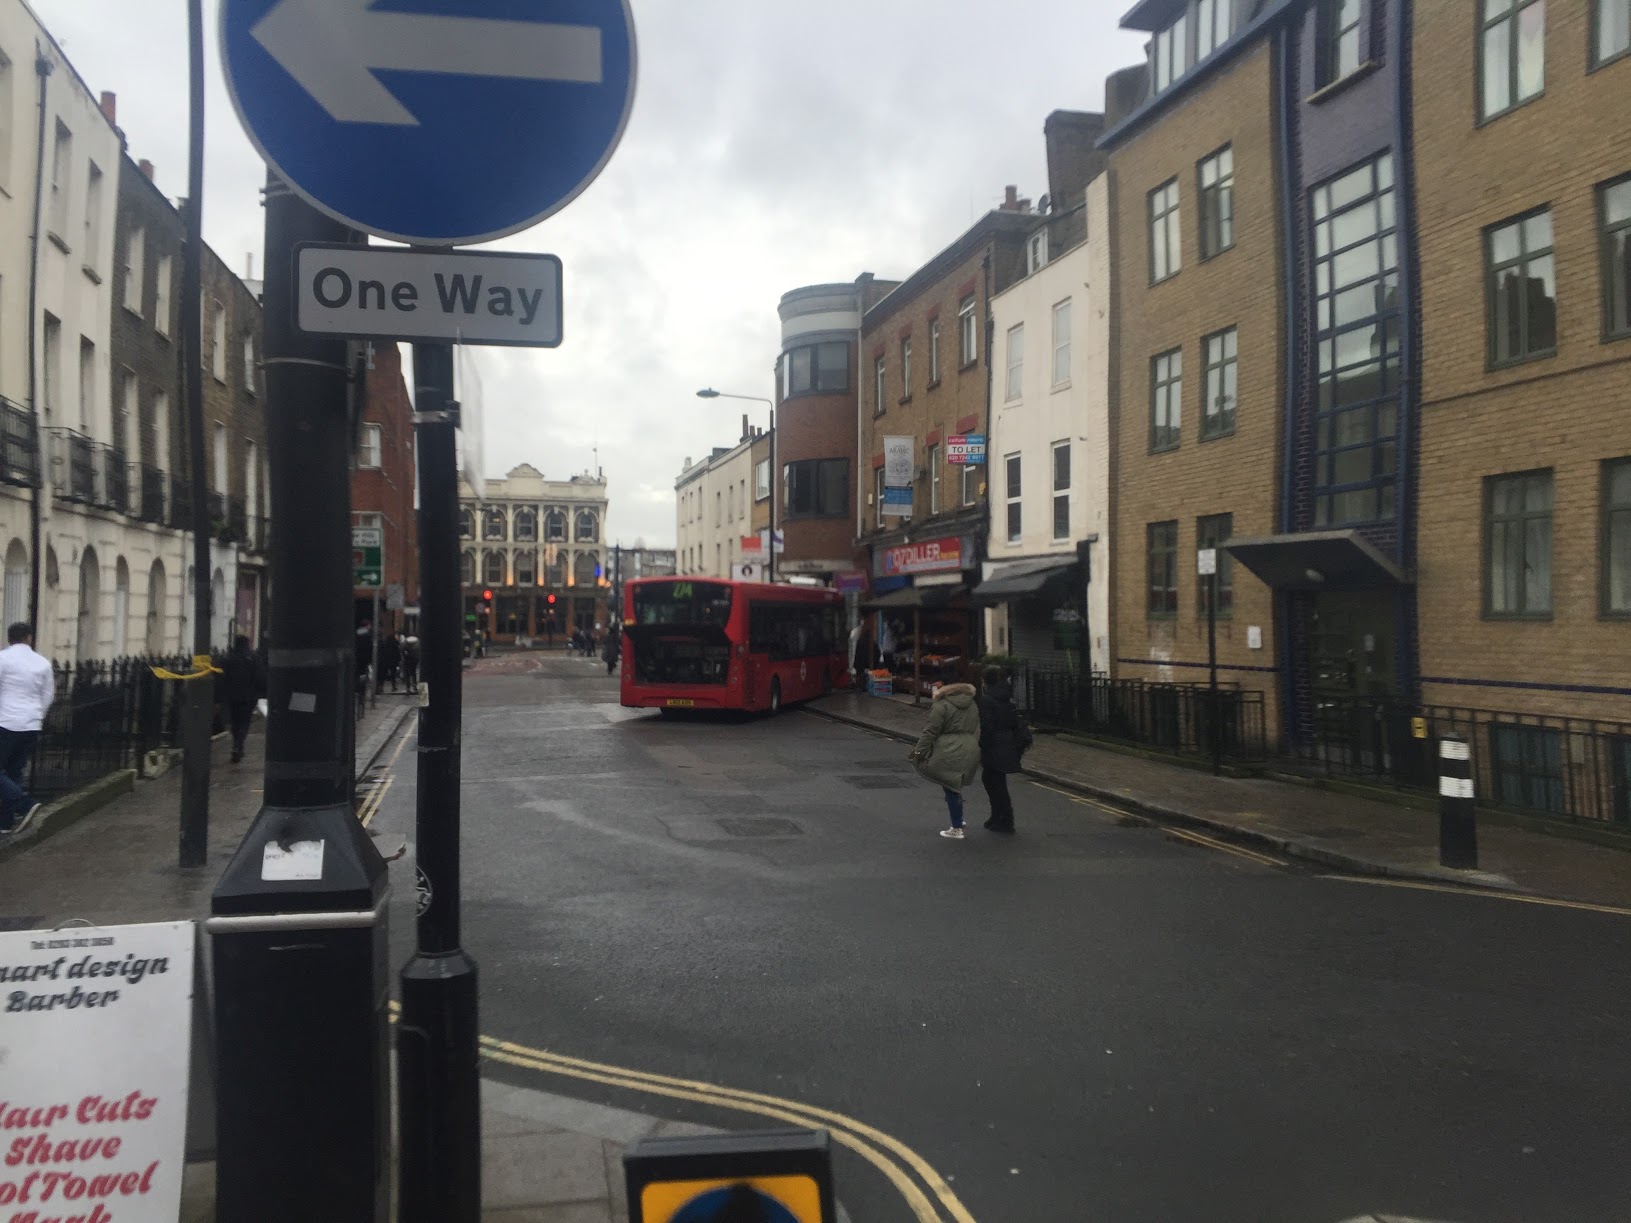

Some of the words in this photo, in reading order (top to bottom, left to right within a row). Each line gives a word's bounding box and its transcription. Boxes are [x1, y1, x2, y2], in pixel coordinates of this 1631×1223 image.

[312, 266, 419, 312] One
[434, 272, 544, 326] Way
[67, 953, 169, 985] design
[5, 985, 120, 1013] Barber
[76, 1090, 159, 1125] Cuts
[5, 1132, 122, 1166] Shave
[40, 1160, 160, 1203] Towel
